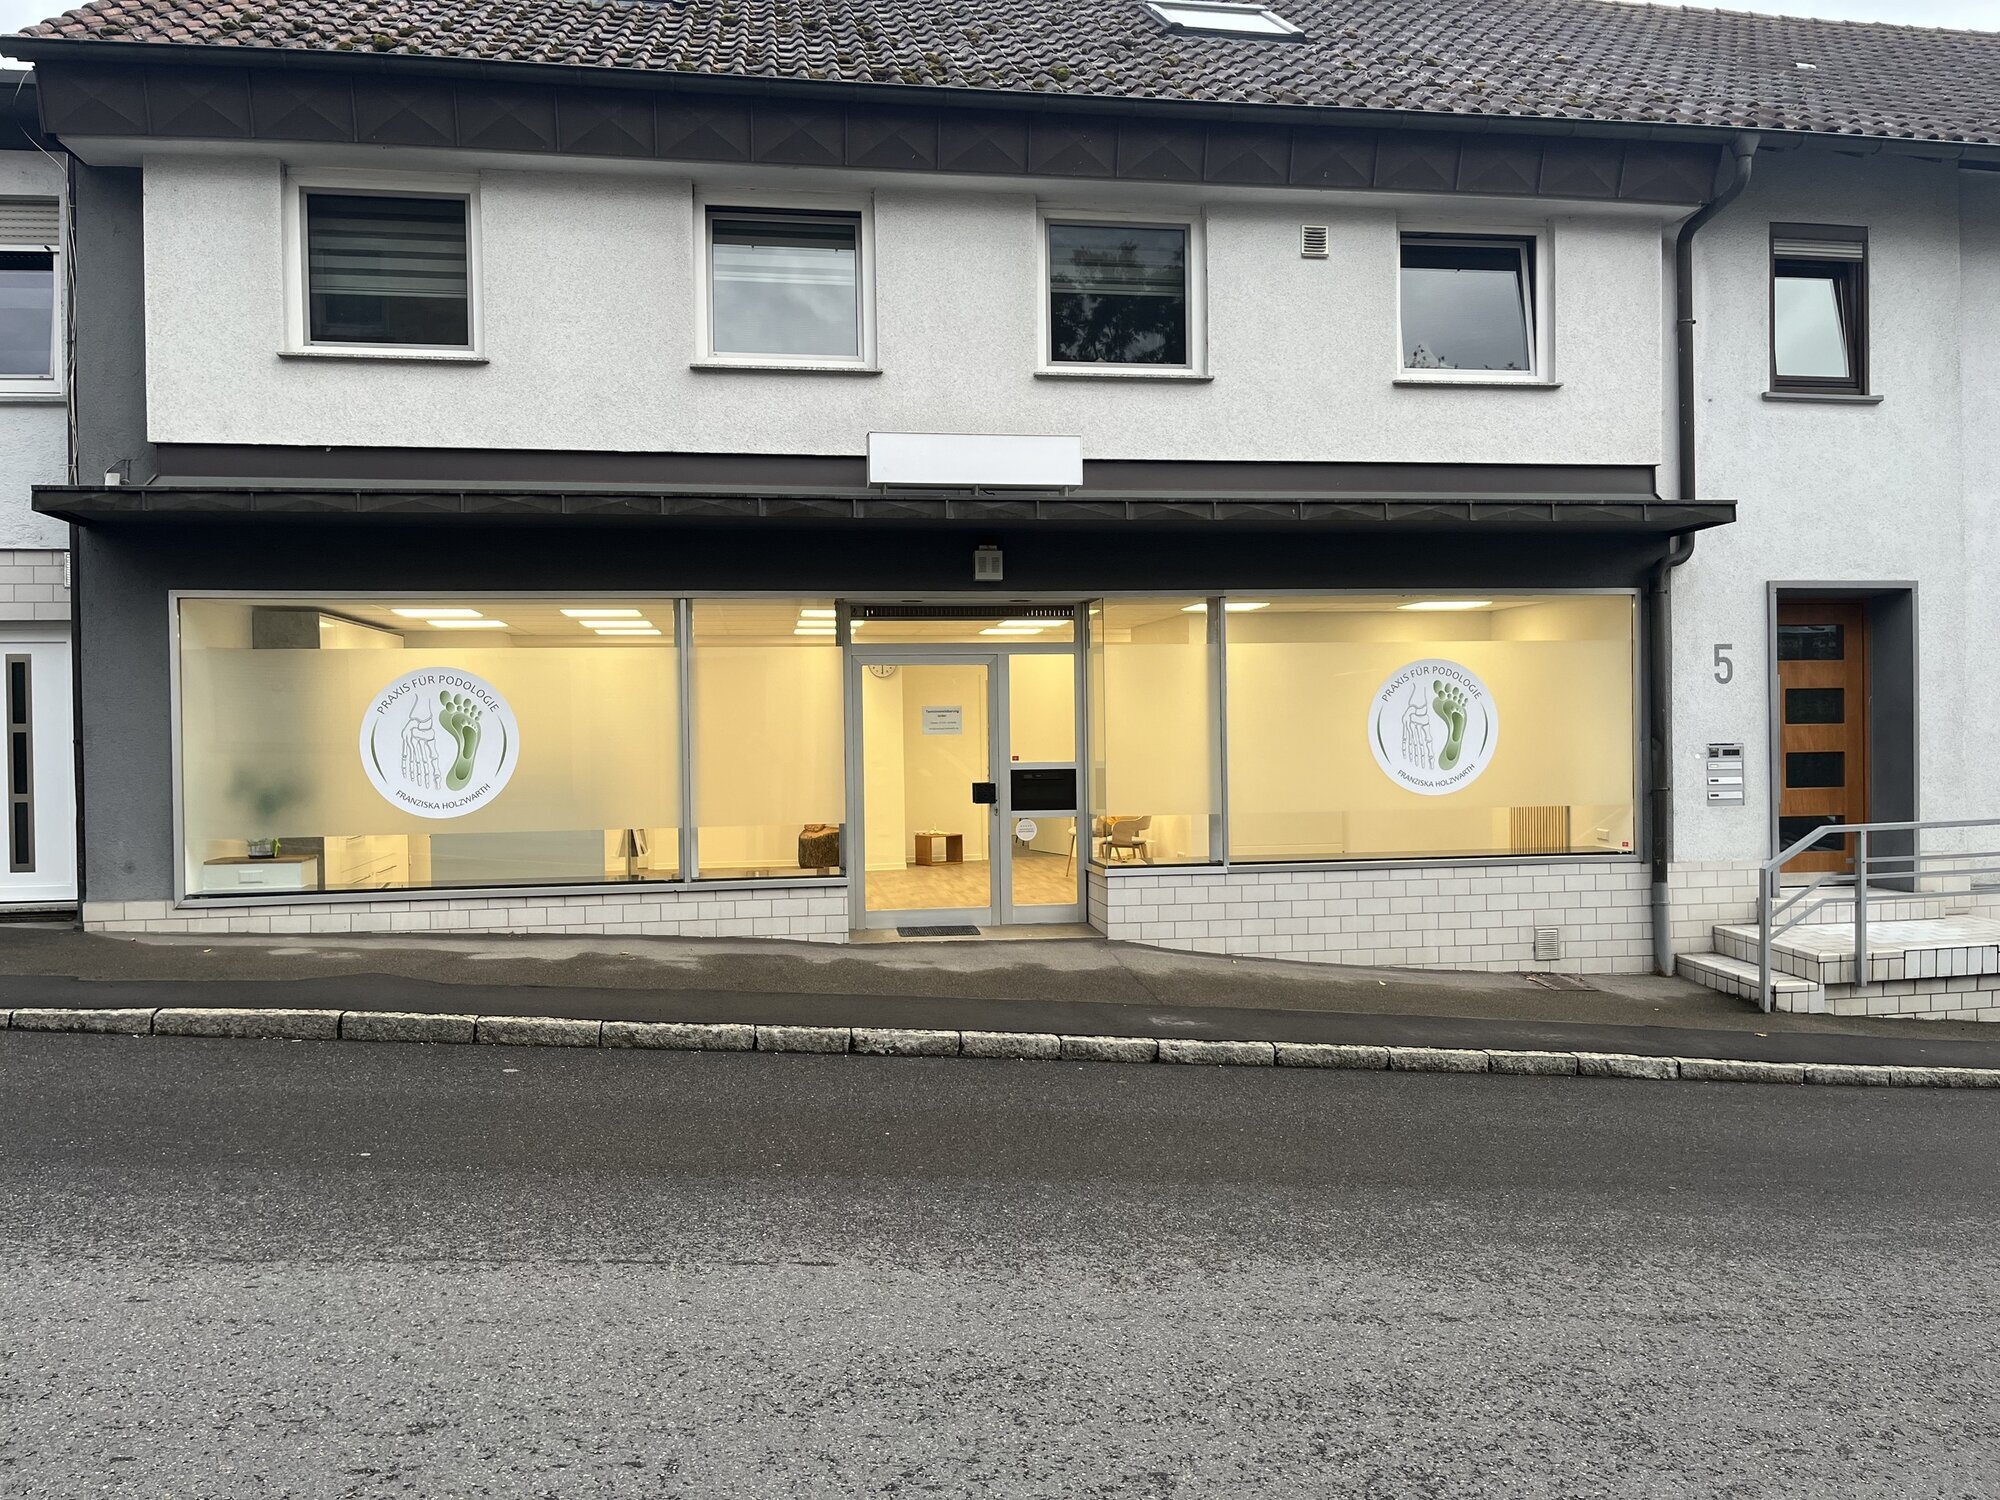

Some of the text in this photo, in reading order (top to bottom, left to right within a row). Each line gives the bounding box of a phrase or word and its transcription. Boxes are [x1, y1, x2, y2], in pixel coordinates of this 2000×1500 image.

[1714, 644, 1733, 684] 5
[377, 675, 499, 714] PRAXIS FÜR PODOLOGIE
[1382, 666, 1482, 702] PRAXIS FÜR PODOLOGIE
[1397, 764, 1475, 787] FRANZISKA HOLZWARTH
[396, 783, 491, 809] FRANZISKA HOLZWARTH
